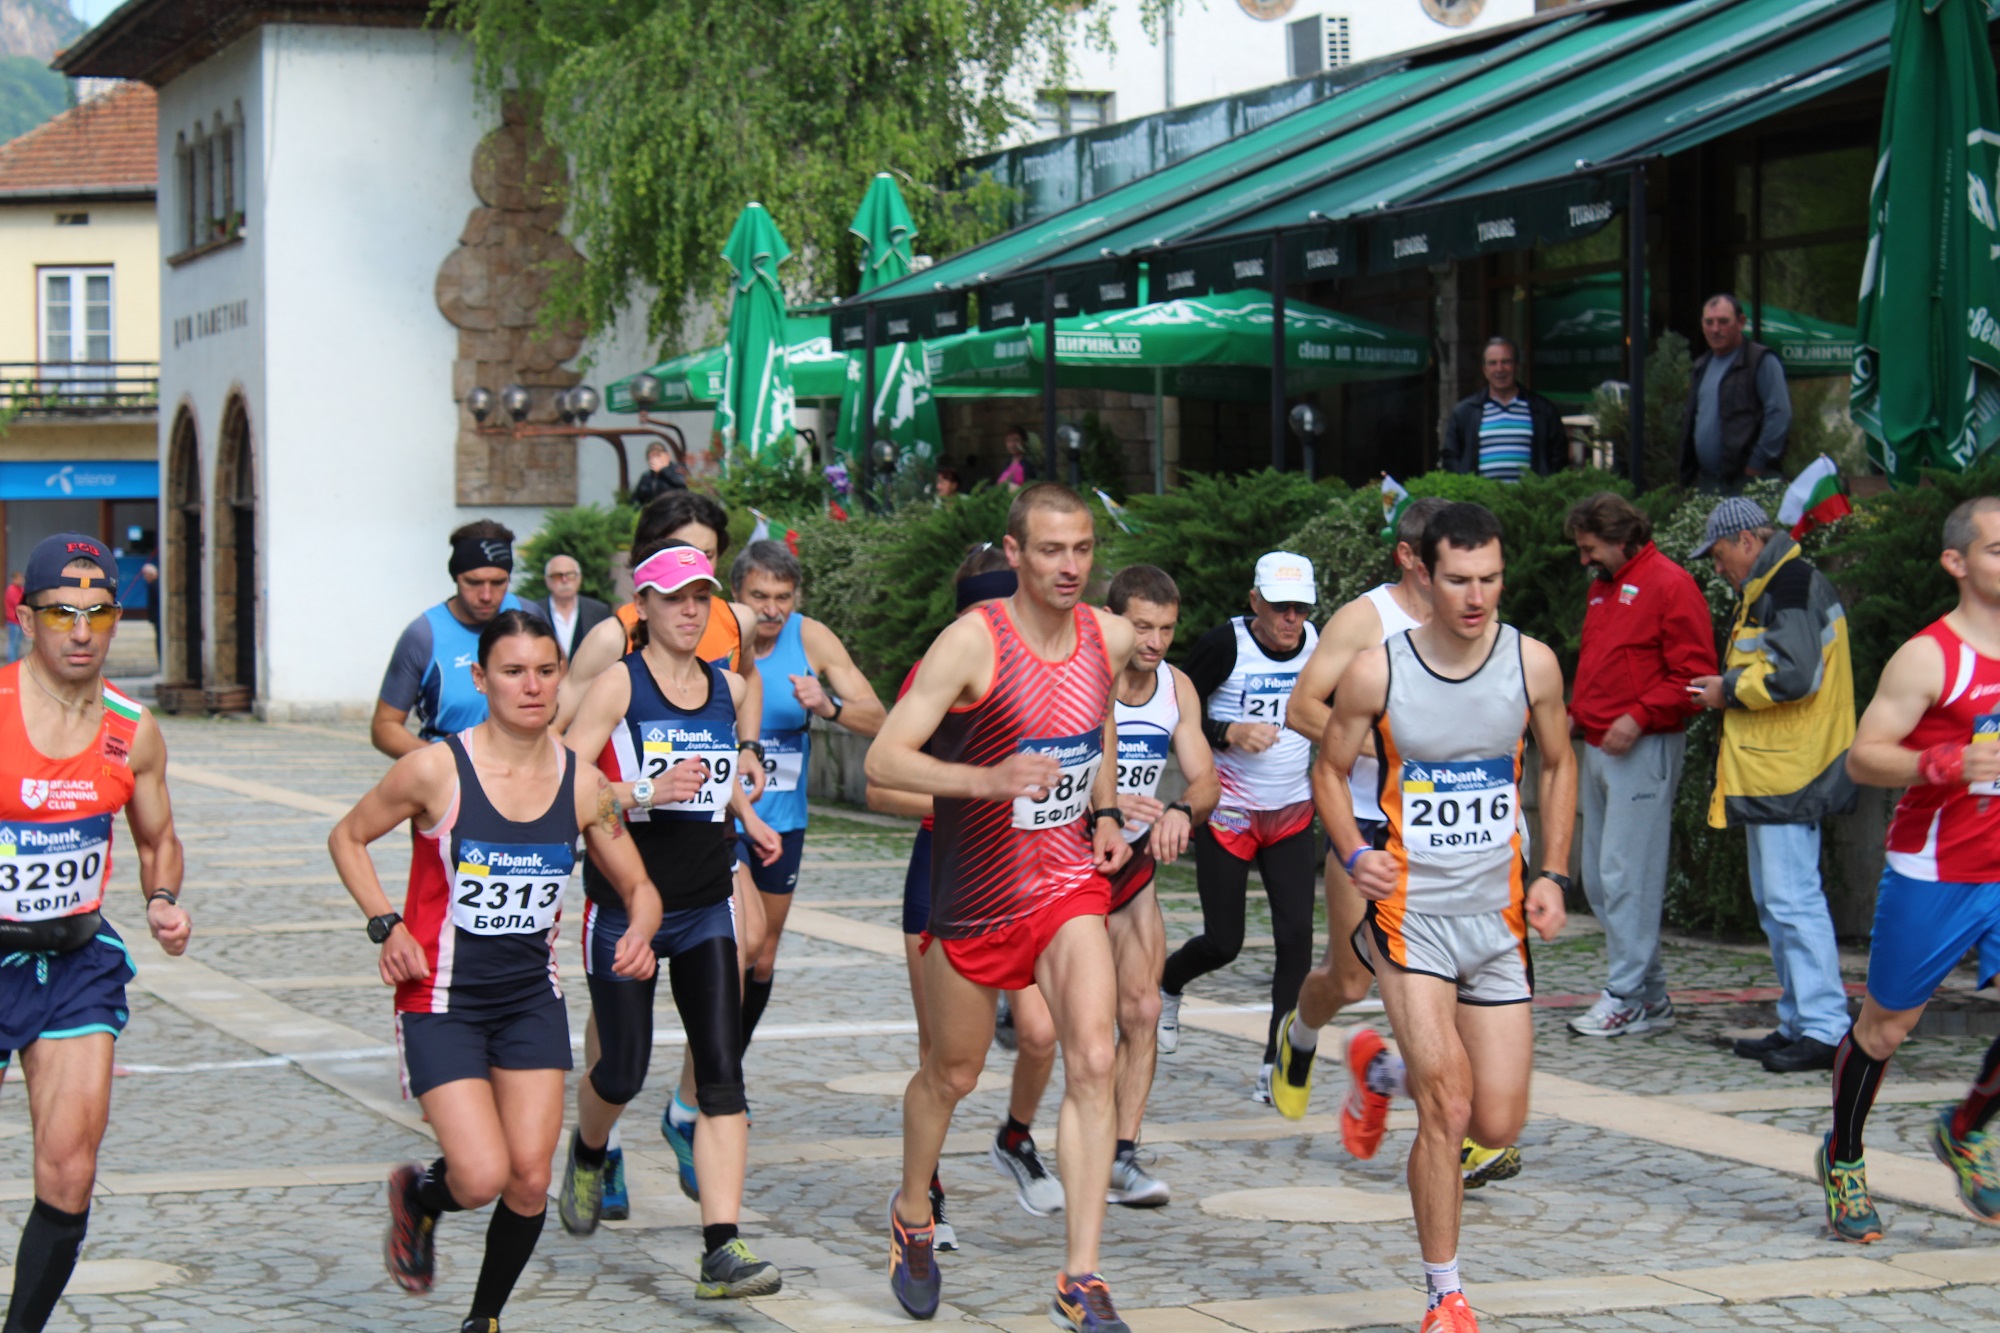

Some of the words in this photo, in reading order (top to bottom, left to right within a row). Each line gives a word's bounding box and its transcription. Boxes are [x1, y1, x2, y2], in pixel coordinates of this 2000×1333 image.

[1569, 200, 1613, 227] TUBORG
[1477, 217, 1517, 243] TUBORG
[1055, 336, 1141, 353] ПИРИНСКО
[74, 471, 117, 487] telenor
[1249, 699, 1280, 717] 21
[667, 728, 712, 743] Fibank
[1118, 740, 1149, 753] bank
[648, 757, 731, 784] 209
[1431, 767, 1488, 784] Fibank
[48, 790, 99, 801] RUNNING
[47, 800, 77, 811] CLUB
[1410, 793, 1509, 827] 2016
[1034, 805, 1083, 825] БФЛА
[20, 828, 81, 847] Fibank
[1430, 830, 1492, 847] БФЛА
[488, 852, 543, 867] Fibank
[0, 852, 100, 892] 3290
[16, 891, 81, 913] БФЛА
[457, 880, 560, 909] 2313
[473, 915, 536, 928] БФЛА
